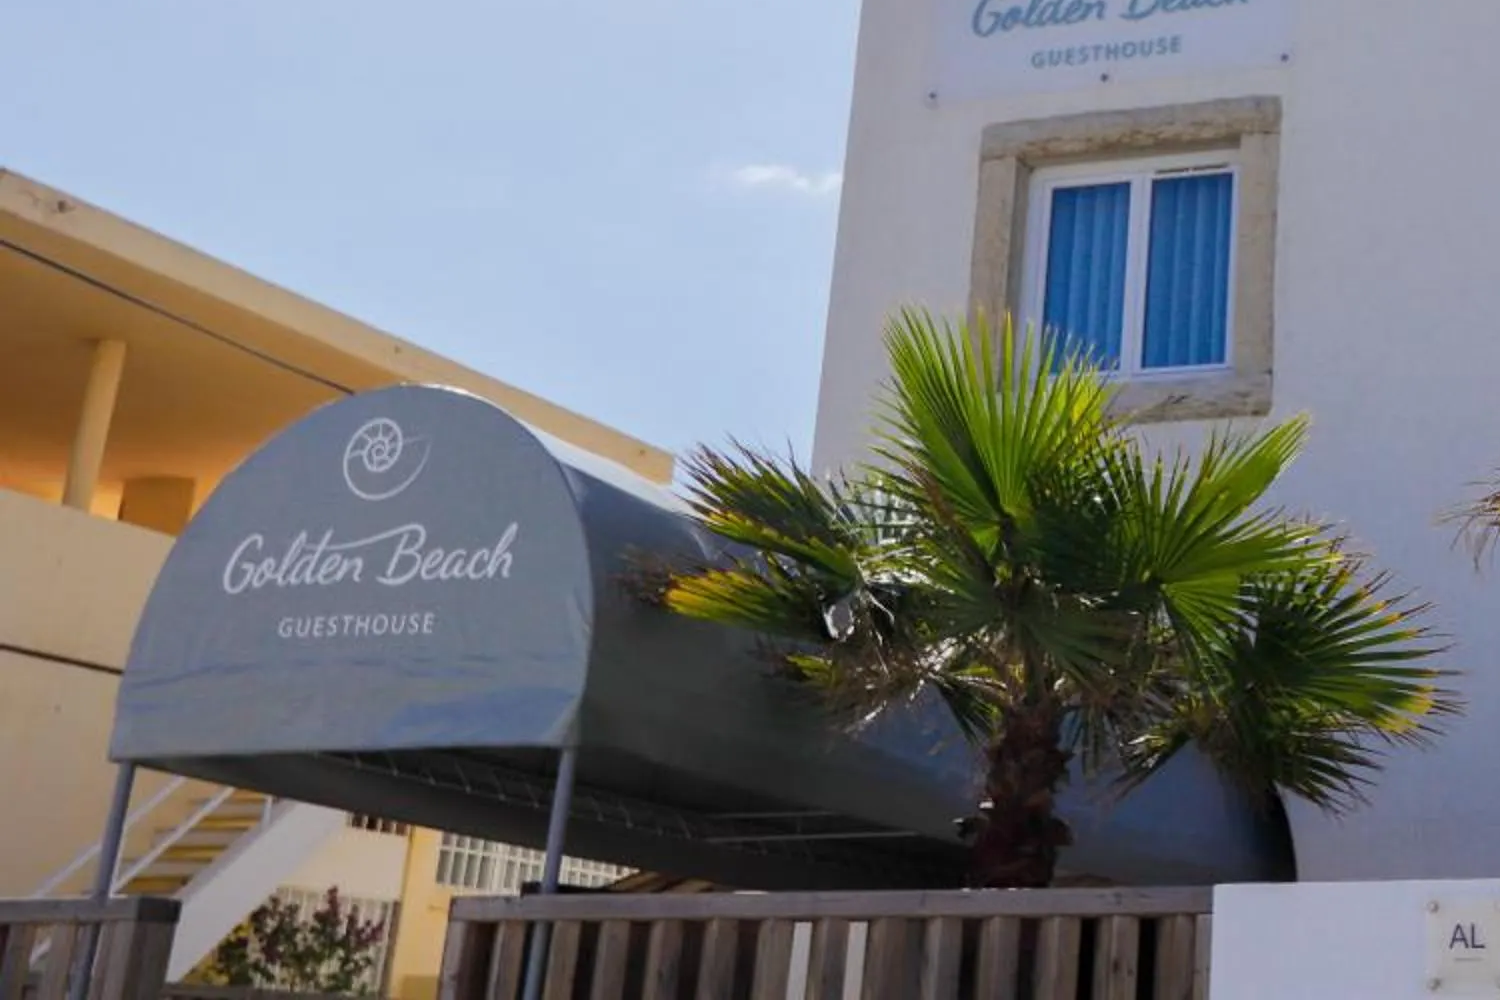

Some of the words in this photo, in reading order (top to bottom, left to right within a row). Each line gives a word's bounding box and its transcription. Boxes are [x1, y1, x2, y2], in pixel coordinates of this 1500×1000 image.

[1031, 35, 1182, 69] GUESTHOUSE
[222, 527, 363, 594] Golden
[376, 522, 519, 586] Beach
[278, 612, 436, 639] GUESTHOUSE
[1448, 922, 1486, 950] AL
